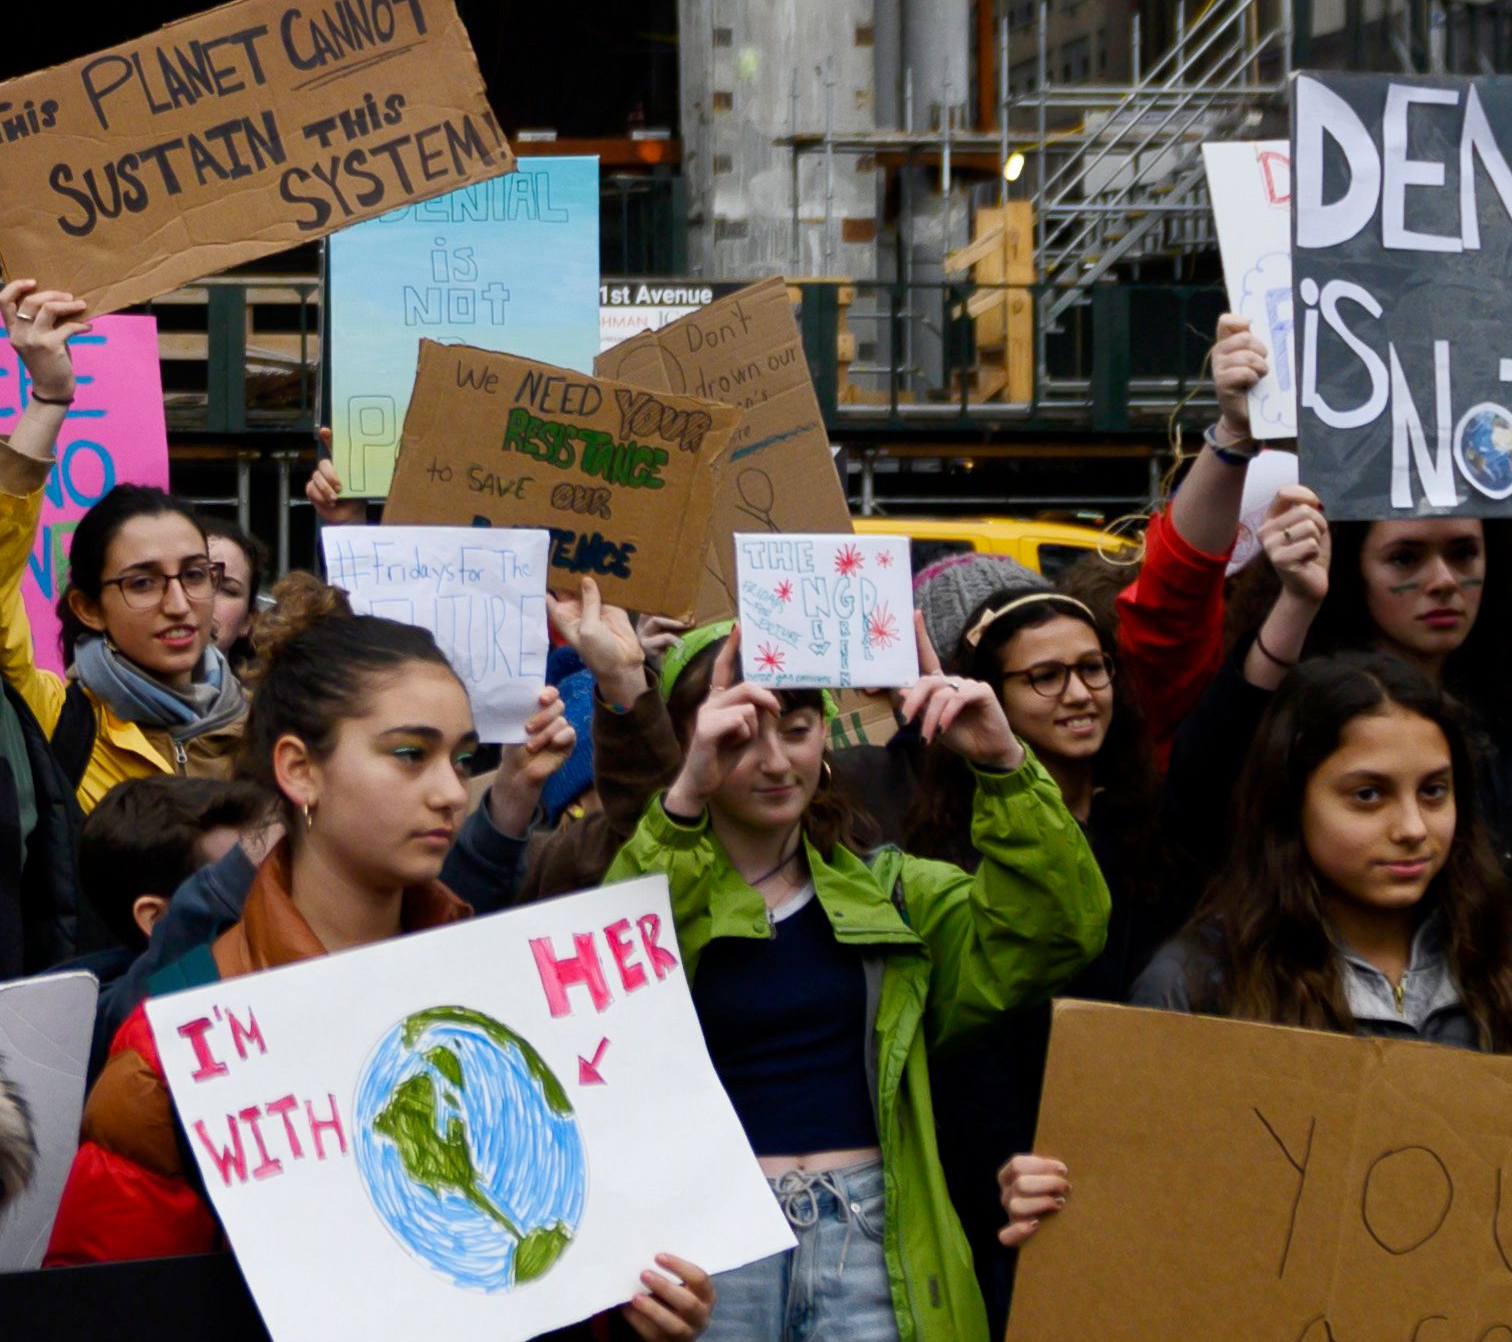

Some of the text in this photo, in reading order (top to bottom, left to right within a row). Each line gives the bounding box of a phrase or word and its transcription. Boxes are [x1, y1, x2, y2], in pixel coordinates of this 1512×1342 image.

[81, 25, 269, 130] PLANET
[49, 109, 286, 237] SUSTAIN
[279, 111, 511, 231] SYSTEM!
[598, 285, 713, 305] 1st Avenue
[598, 315, 648, 327] HMAN
[686, 300, 752, 354] Don't
[456, 360, 499, 396] We
[514, 369, 603, 417] NEED
[614, 388, 713, 454] YOUR
[696, 346, 797, 398] drown our
[426, 458, 613, 521] to SAVE OUR
[490, 549, 534, 584] The
[742, 541, 816, 573] THE
[527, 911, 679, 1020] HER
[175, 1005, 269, 1084] I'M
[192, 1092, 351, 1188] WITH
